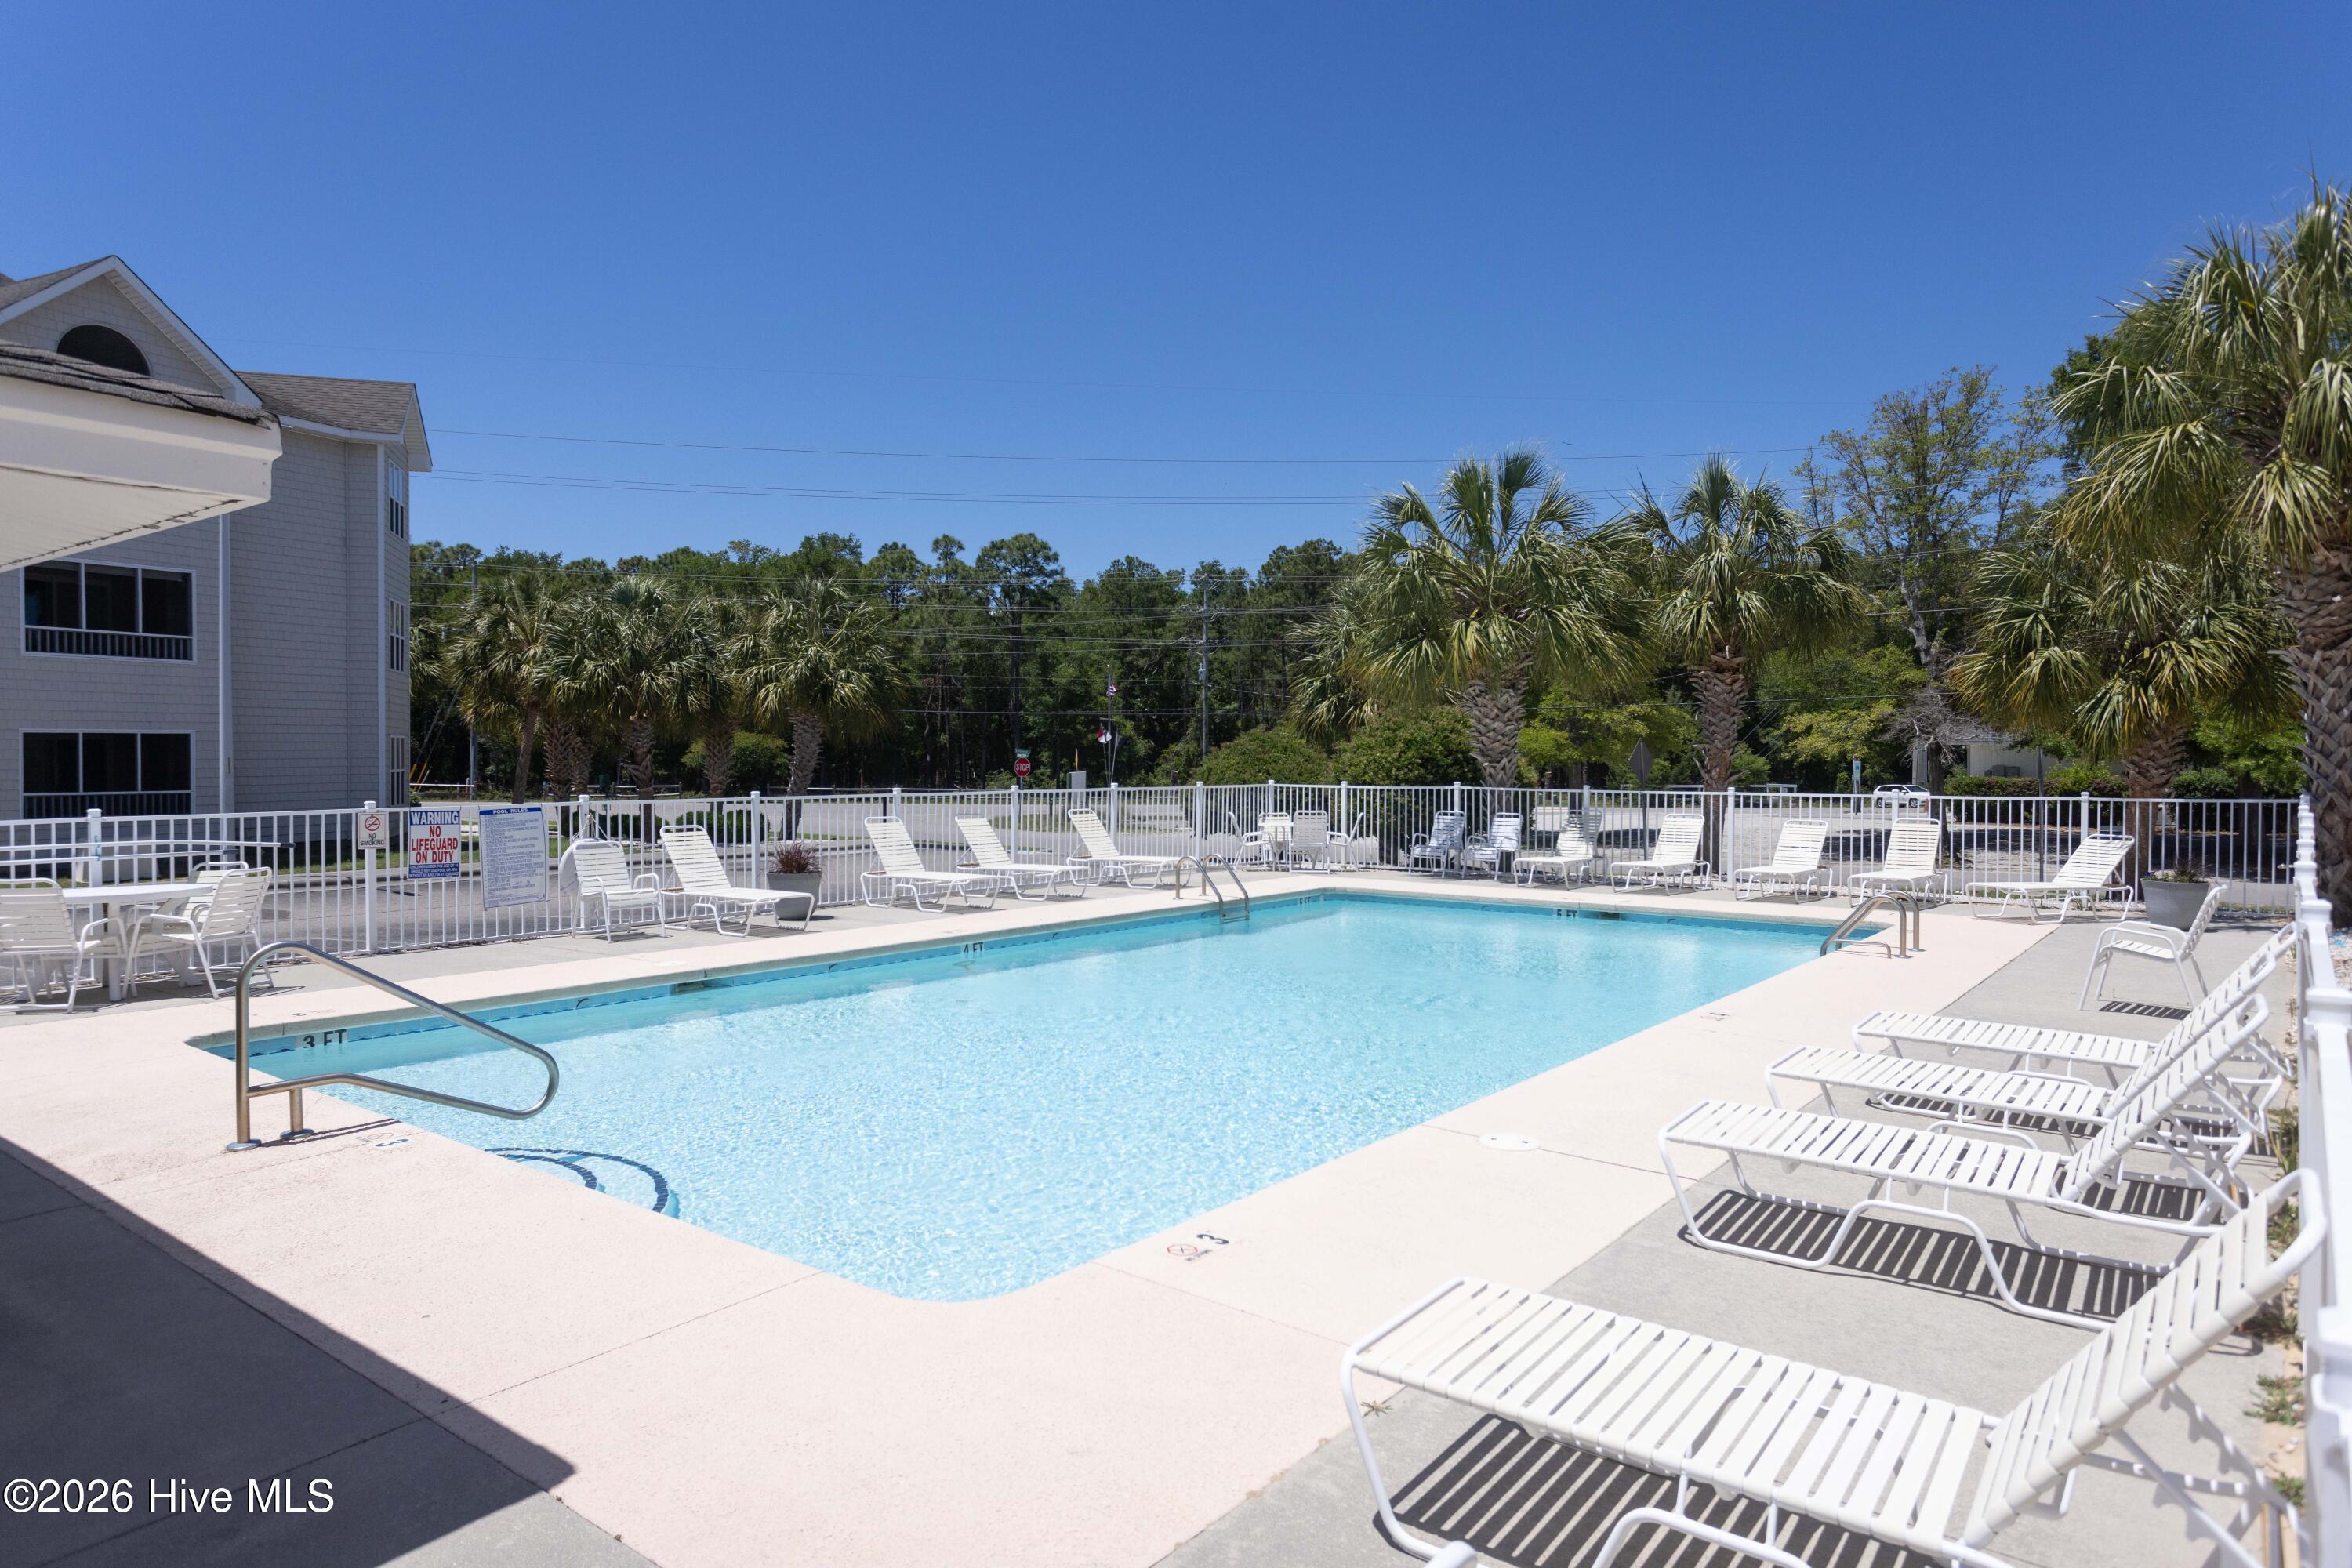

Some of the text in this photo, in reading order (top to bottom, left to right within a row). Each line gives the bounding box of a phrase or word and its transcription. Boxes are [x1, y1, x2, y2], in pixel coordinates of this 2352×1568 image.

[411, 811, 459, 825] WARNING
[430, 826, 441, 837] NO
[411, 838, 459, 851] LIFEGUARD
[416, 851, 454, 864] ON DUTY
[1566, 909, 1577, 918] FT
[972, 942, 984, 952] FT
[303, 1028, 347, 1049] 3 FT
